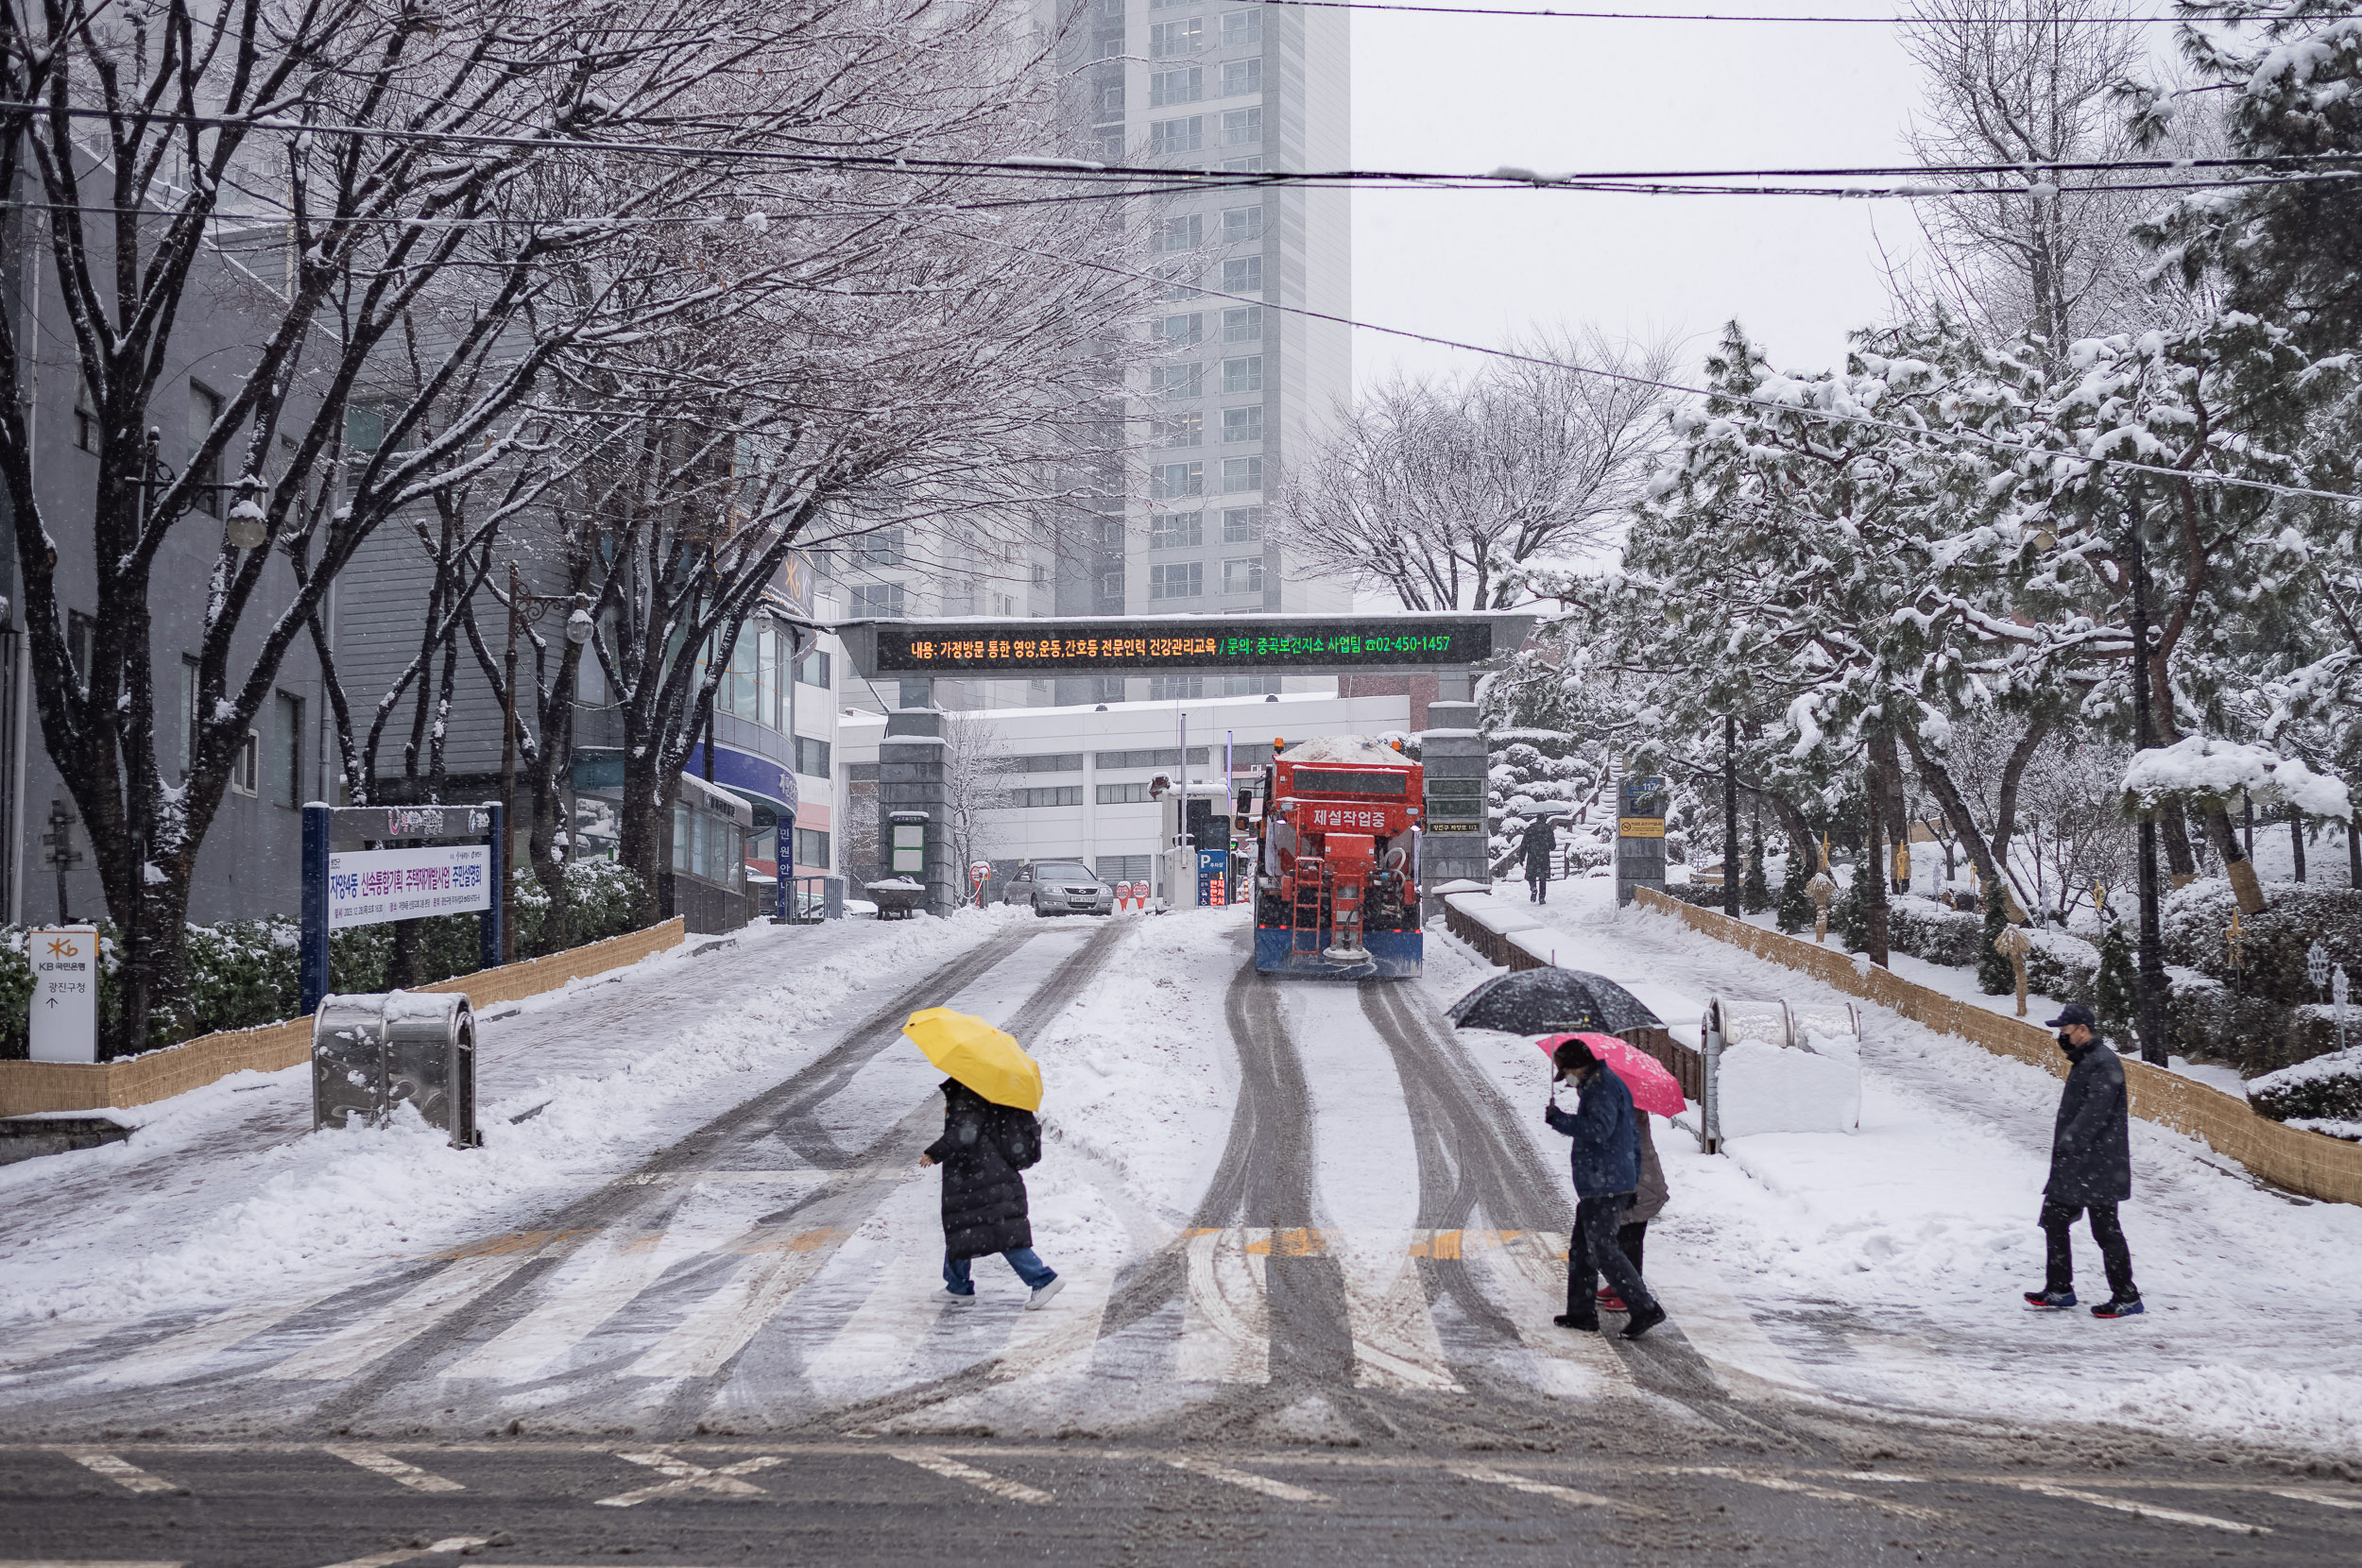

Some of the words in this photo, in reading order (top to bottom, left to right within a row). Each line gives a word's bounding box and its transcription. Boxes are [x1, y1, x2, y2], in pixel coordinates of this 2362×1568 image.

[911, 640, 938, 660] 내용:
[940, 640, 984, 659] 가정방문
[987, 640, 1011, 659] 통한
[1013, 639, 1099, 659] 영양,운동,간호등
[1102, 639, 1146, 657] 전문인력
[1150, 638, 1217, 657] 건강관리교육
[1227, 638, 1254, 656] 문의:
[1257, 637, 1325, 656] 중곡보건지소
[1327, 636, 1361, 655] 사업팀
[1313, 809, 1386, 827] 제설작업중
[1200, 854, 1211, 869] P
[330, 873, 358, 899] 자양4동
[361, 869, 402, 896] 신속통합기획
[405, 866, 450, 892] 주택재개발사업
[452, 863, 482, 888] 주민설명회
[1218, 871, 1224, 880] 1
[1209, 879, 1225, 889] 만차
[39, 962, 54, 971] KB
[55, 962, 86, 971] 국민은행
[48, 981, 86, 994] 광진구청
